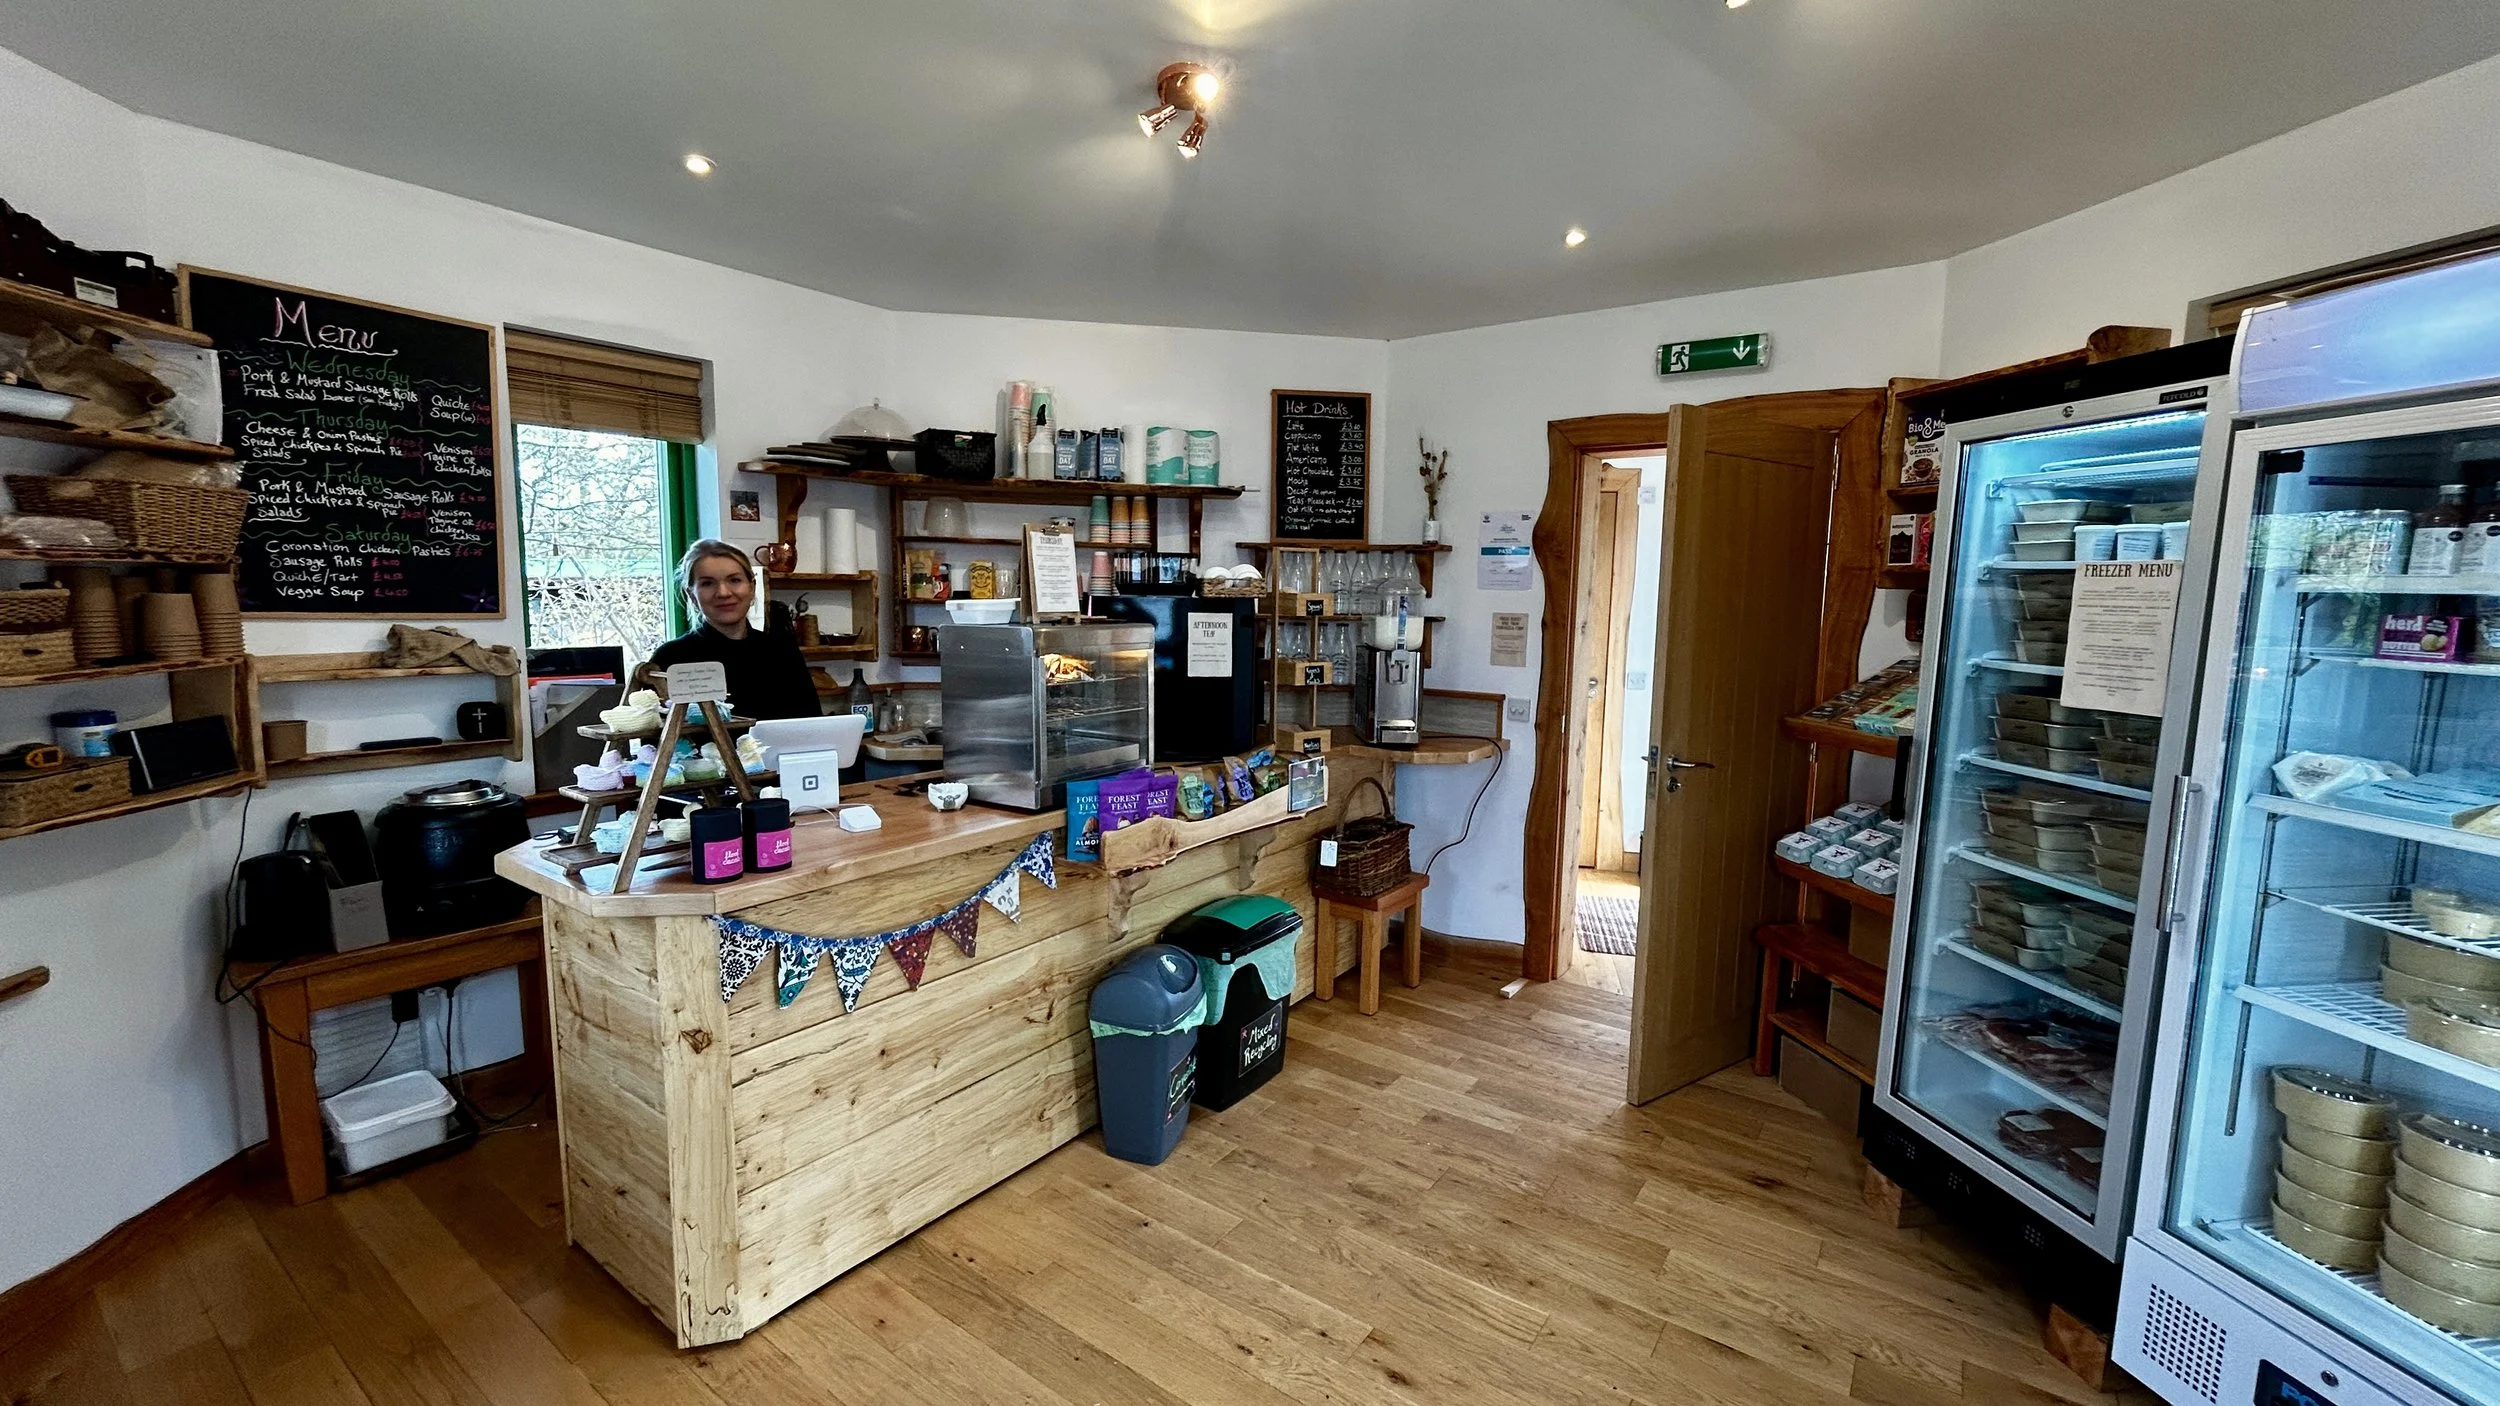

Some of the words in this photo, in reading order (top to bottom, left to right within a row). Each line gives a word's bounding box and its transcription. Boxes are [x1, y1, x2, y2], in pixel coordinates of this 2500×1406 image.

[272, 297, 379, 349] Menu
[286, 350, 410, 391] Wednesday
[240, 364, 274, 383] Pork
[280, 371, 290, 384] &
[296, 374, 342, 391] Mustard
[344, 380, 392, 399] Sausage
[394, 386, 420, 404] Rolls
[244, 384, 281, 399] Fresh
[431, 394, 470, 412] Quiche
[1285, 400, 1308, 414] Hot
[245, 421, 297, 437] Cheese
[302, 426, 312, 439] &
[295, 405, 389, 440] Thursday
[240, 434, 277, 449] Spiced
[389, 445, 404, 457] Pie
[252, 446, 292, 459] Salads
[1910, 447, 1939, 456] GRANOLA
[1285, 452, 1328, 465] Americano
[324, 462, 385, 496] Friday
[1286, 466, 1300, 476] Hot
[258, 479, 290, 493] Pork
[296, 480, 303, 493] &
[315, 480, 367, 498] Mustard
[383, 488, 430, 507] Sausage
[431, 489, 456, 504] Rolls
[256, 505, 303, 519] Salads
[382, 507, 399, 519] Pie
[324, 522, 412, 555] Saturday
[265, 540, 350, 554] Coronation
[413, 545, 452, 558] Pasties
[269, 554, 327, 572] Sausage
[334, 554, 363, 567] Rolls
[2084, 563, 2132, 577] FREEZER
[2139, 563, 2174, 577] MENU
[275, 585, 324, 600] Veggie
[330, 587, 365, 602] Soup
[1193, 621, 1228, 630] AFTERNOON
[2385, 614, 2424, 632] herd
[1077, 795, 1099, 804] FORE
[1108, 794, 1141, 803] FOREST
[1111, 802, 1138, 811] FEAST
[1147, 796, 1168, 806] EAST
[1248, 1013, 1276, 1045] Mixed
[1244, 1034, 1278, 1067] Recycling
